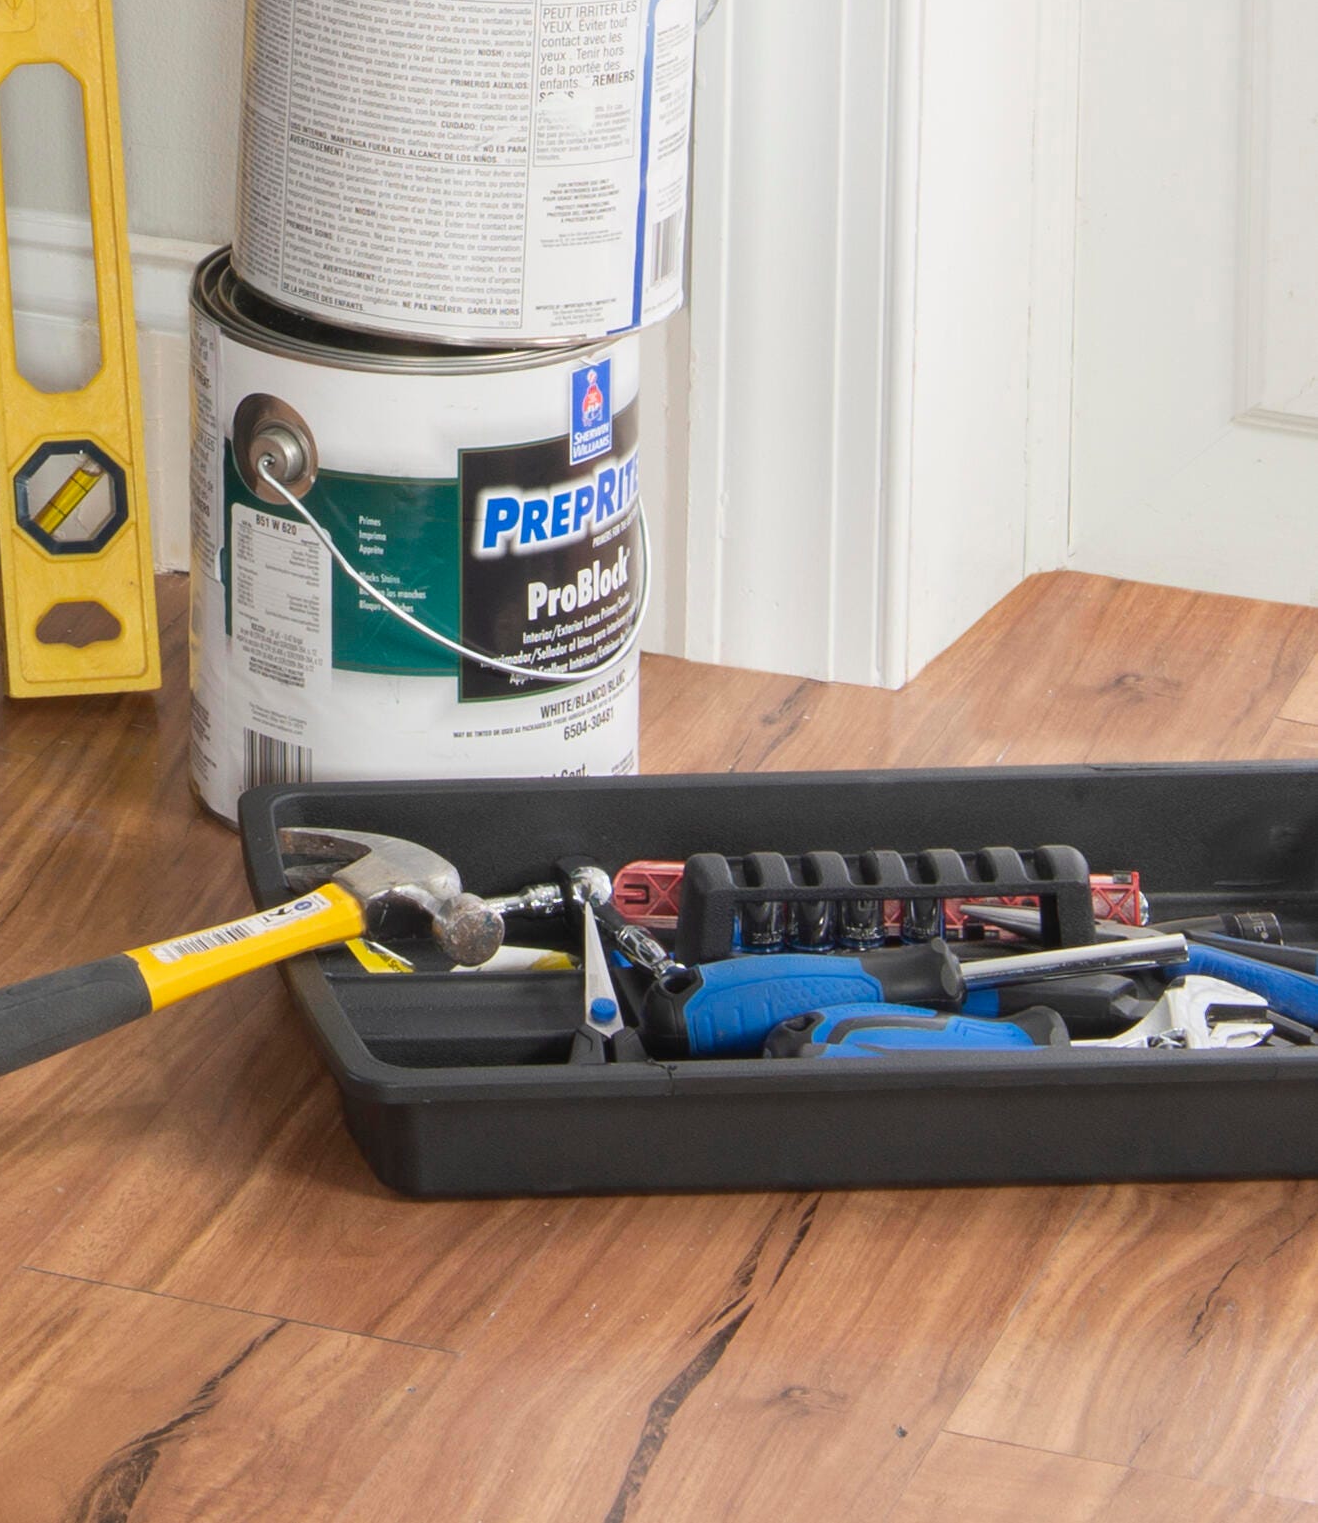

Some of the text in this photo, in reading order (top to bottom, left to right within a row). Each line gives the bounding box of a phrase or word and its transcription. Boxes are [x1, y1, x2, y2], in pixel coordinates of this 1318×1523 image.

[543, 0, 637, 19] PEUT IRRITER LES
[610, 17, 628, 29] tout
[541, 32, 623, 48] contact avec les
[576, 48, 600, 60] Tenir
[603, 46, 625, 57] hors
[540, 64, 553, 76] de
[556, 64, 566, 74] la
[603, 60, 620, 71] des
[592, 69, 635, 86] REMIERS
[368, 142, 390, 152] FUERA
[409, 149, 442, 160] ALCANCE
[573, 435, 609, 458] WILLIAMS
[272, 519, 280, 531] W
[528, 545, 628, 621] ProBlock
